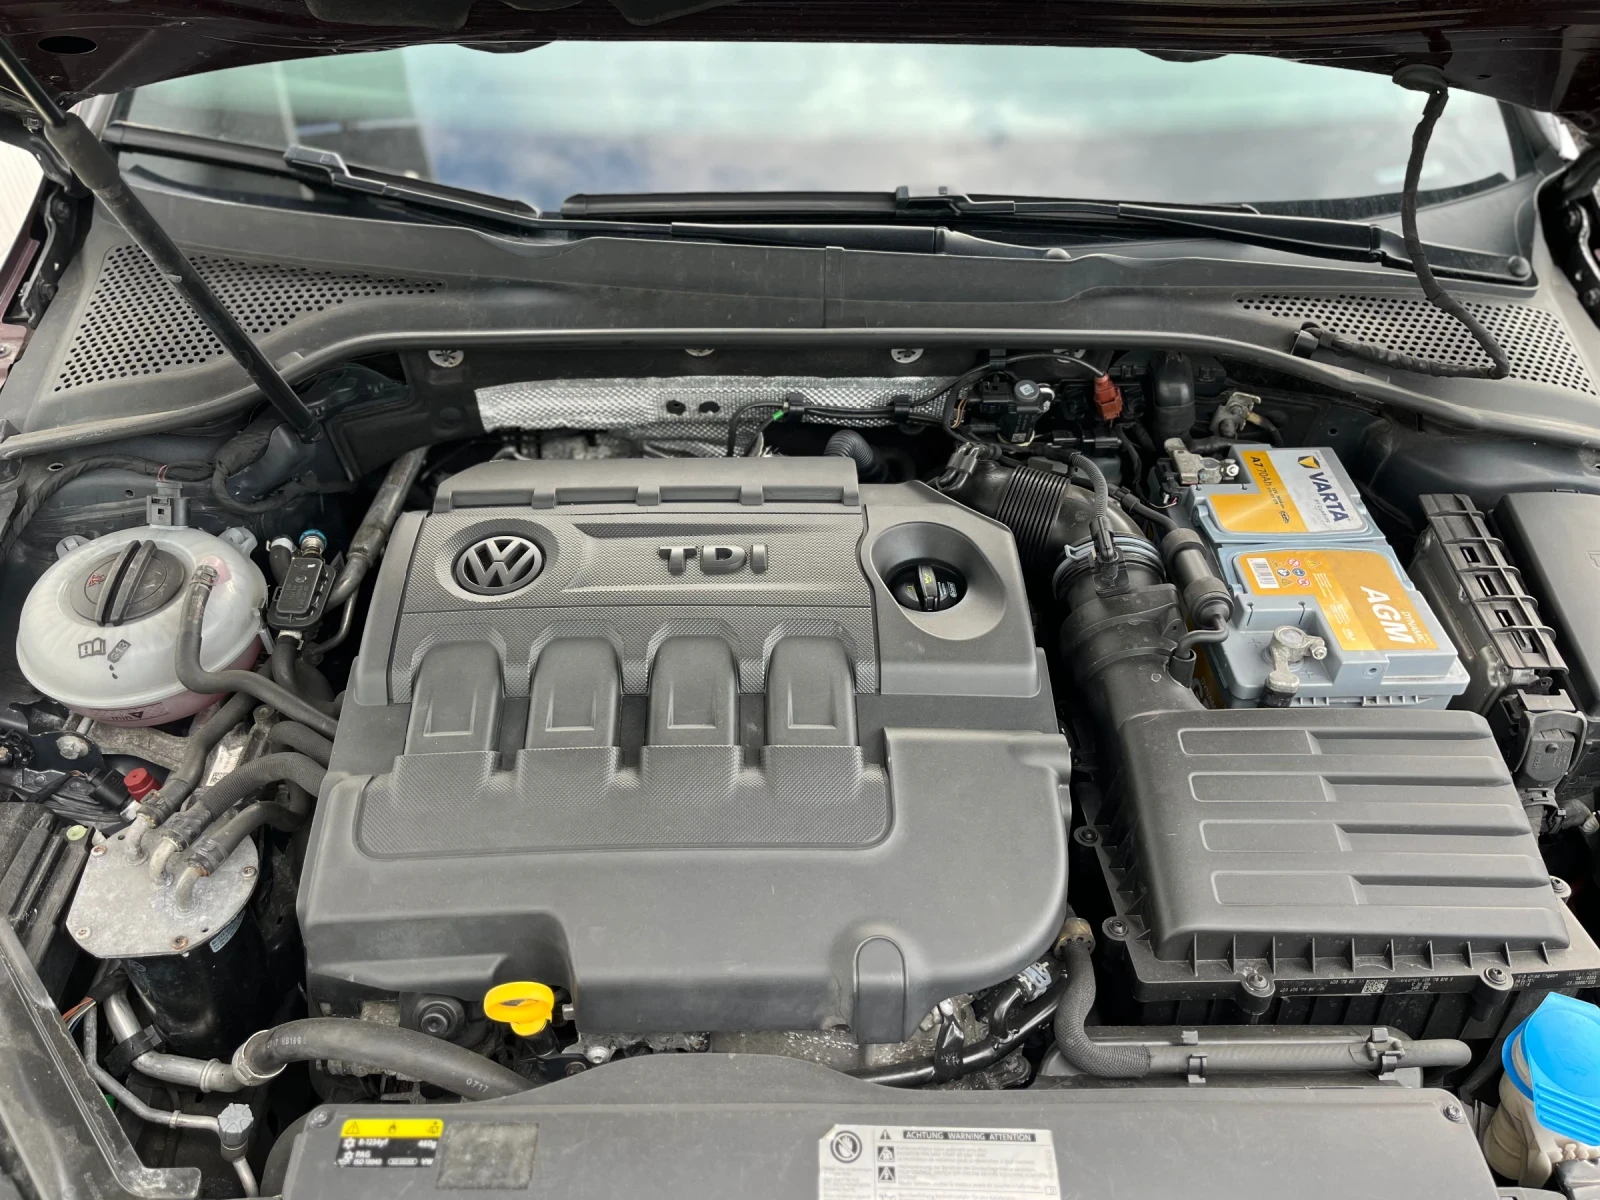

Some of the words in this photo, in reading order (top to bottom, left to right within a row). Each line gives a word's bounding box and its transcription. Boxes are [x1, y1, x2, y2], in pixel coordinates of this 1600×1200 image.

[1250, 456, 1264, 468] A7
[1308, 471, 1350, 523] VARTA
[657, 544, 768, 575] TDI
[1359, 585, 1417, 645] AGM
[1401, 610, 1428, 644] DYNAMIC
[111, 641, 128, 660] G13
[466, 1077, 489, 1093] 0717
[905, 1130, 944, 1140] ACHTUNG
[948, 1131, 986, 1141] WARNING
[989, 1132, 1031, 1142] ATTENTION
[417, 1139, 438, 1150] 460g
[355, 1150, 371, 1158] PAG
[421, 1158, 434, 1166] VW
